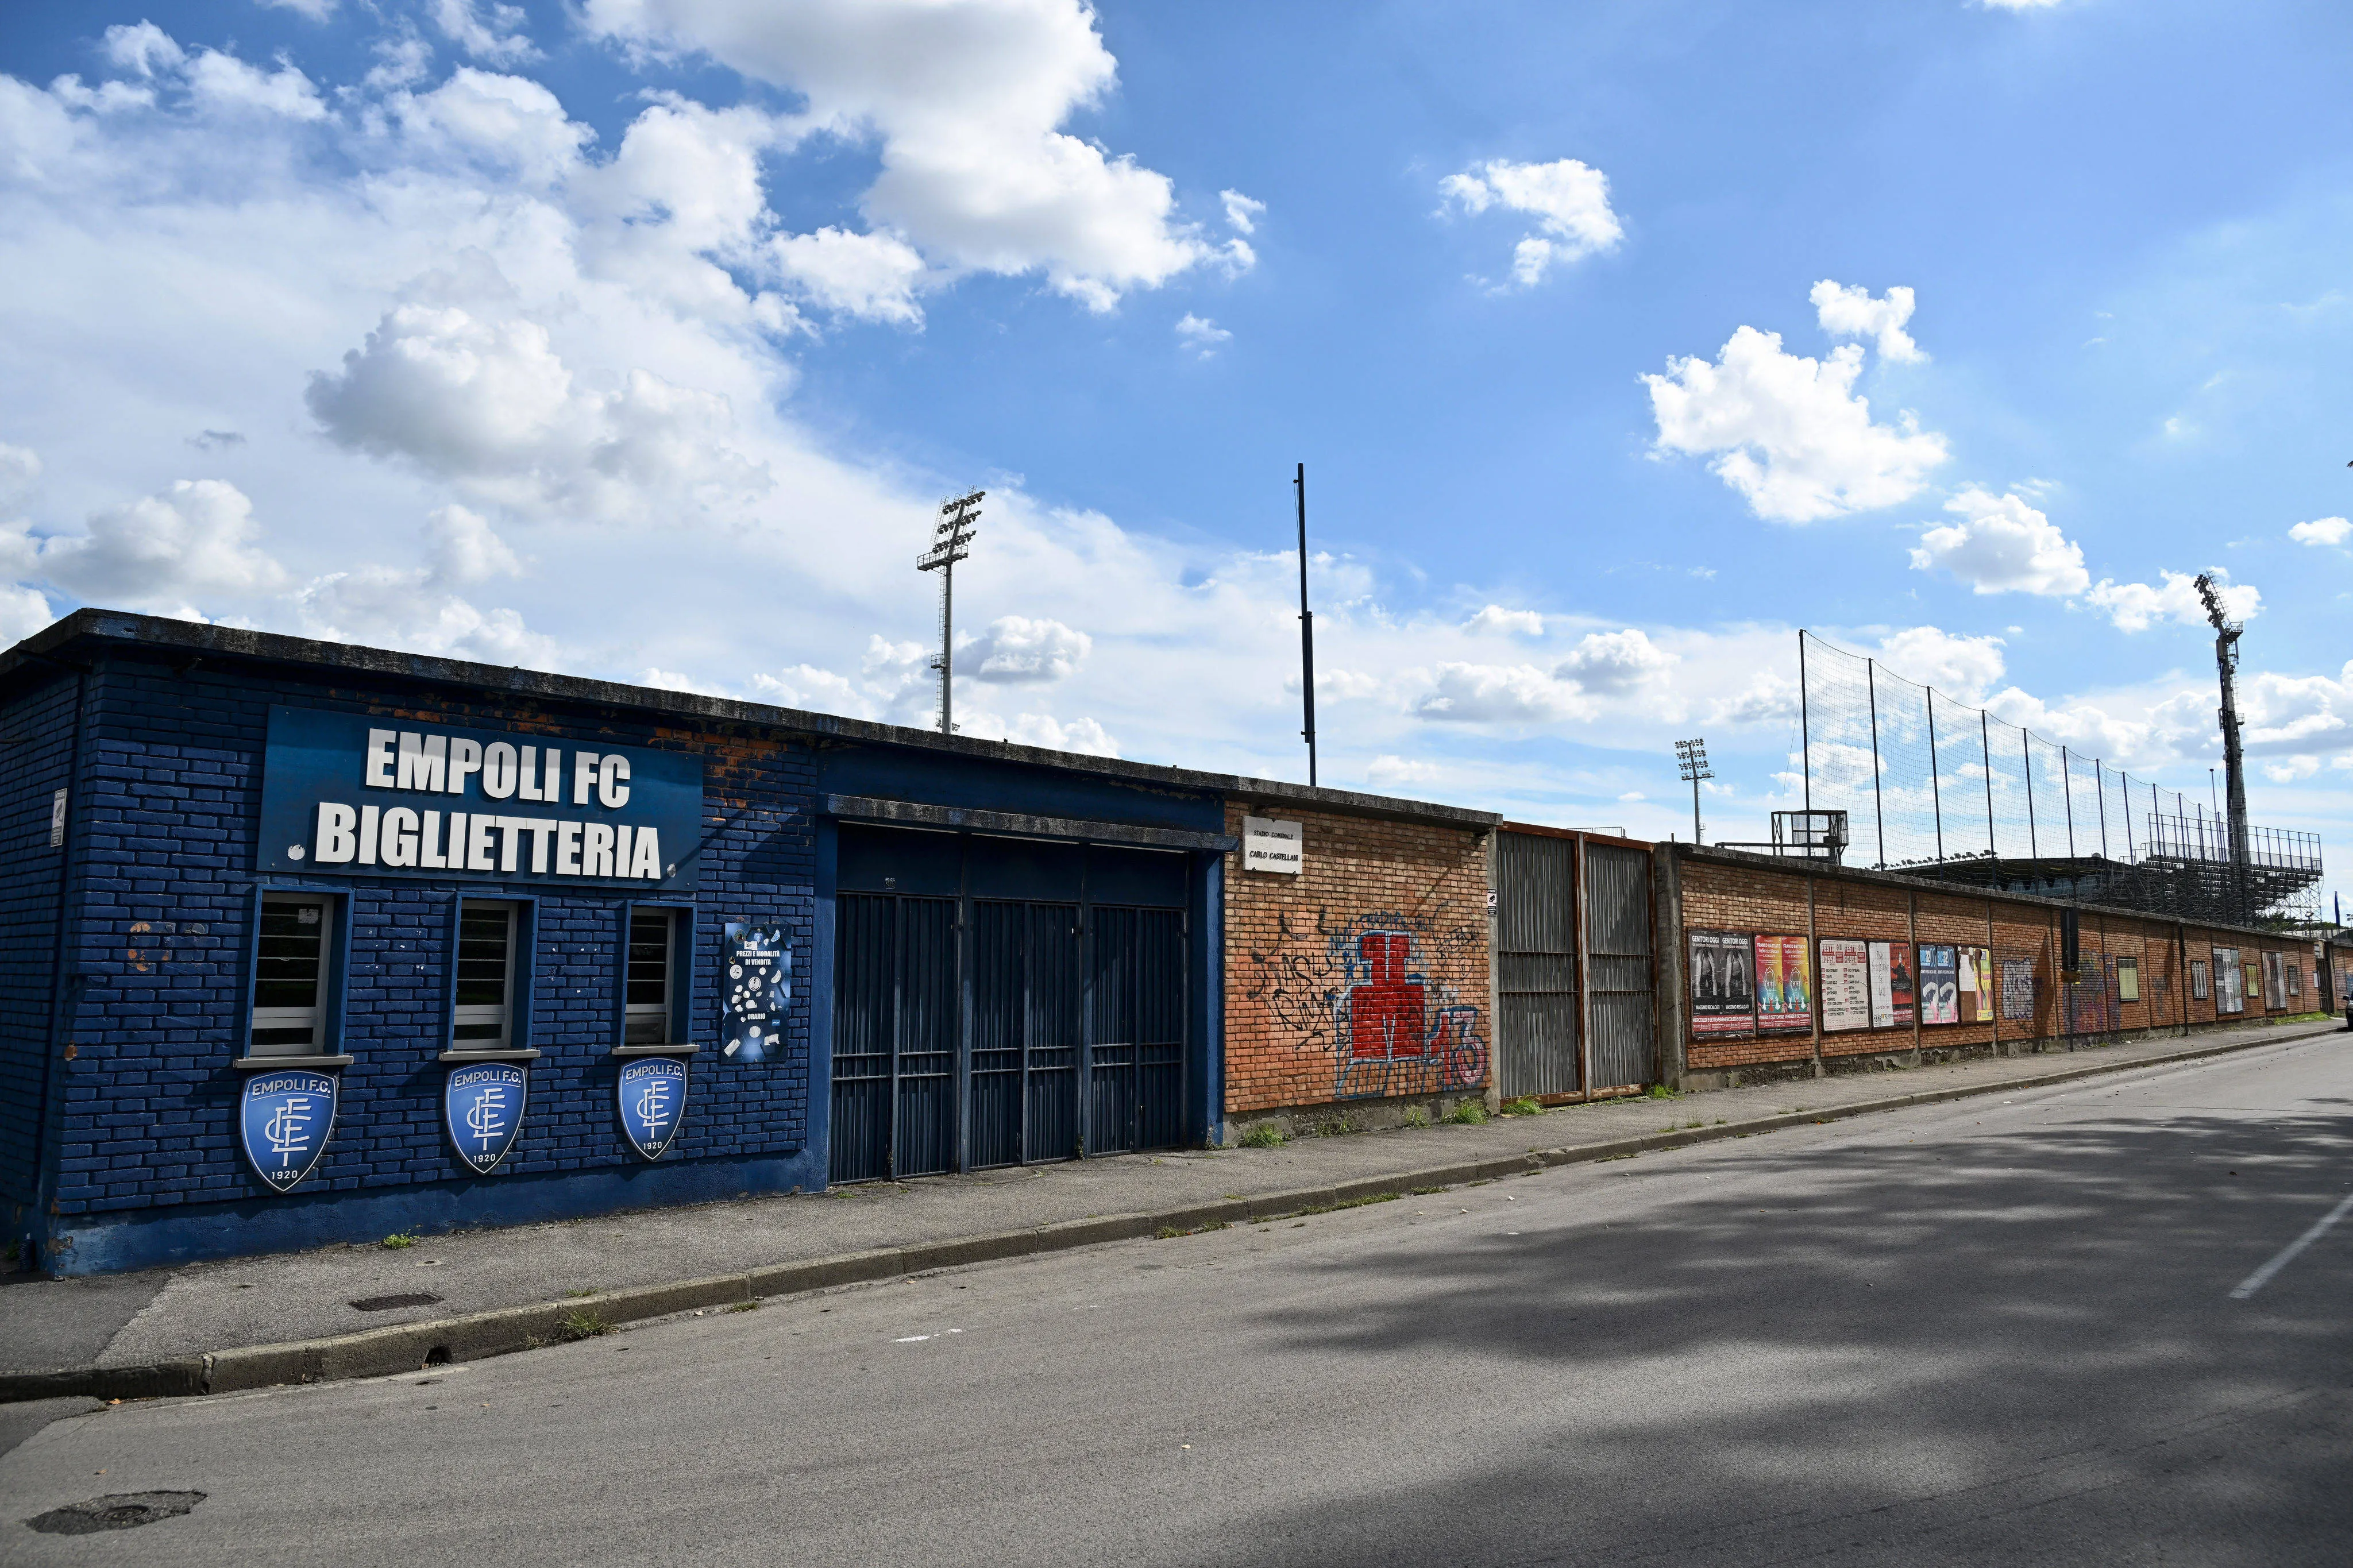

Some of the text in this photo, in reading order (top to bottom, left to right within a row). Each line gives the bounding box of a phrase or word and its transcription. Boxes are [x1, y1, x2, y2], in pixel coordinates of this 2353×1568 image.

[366, 728, 631, 808] EMPOLI FC
[315, 802, 661, 879] BIGLIETTERIA
[1271, 832, 1294, 840] COMUNALE
[1249, 850, 1298, 861] CARLO CASTELLANI
[626, 1064, 682, 1080] EMPOLI F.C.
[454, 1071, 521, 1087] EMPOLI F.C.
[252, 1079, 331, 1096] EMPOLI F.C.
[643, 1141, 662, 1150] 1920
[473, 1153, 496, 1163] 1920
[272, 1170, 298, 1180] 1920
